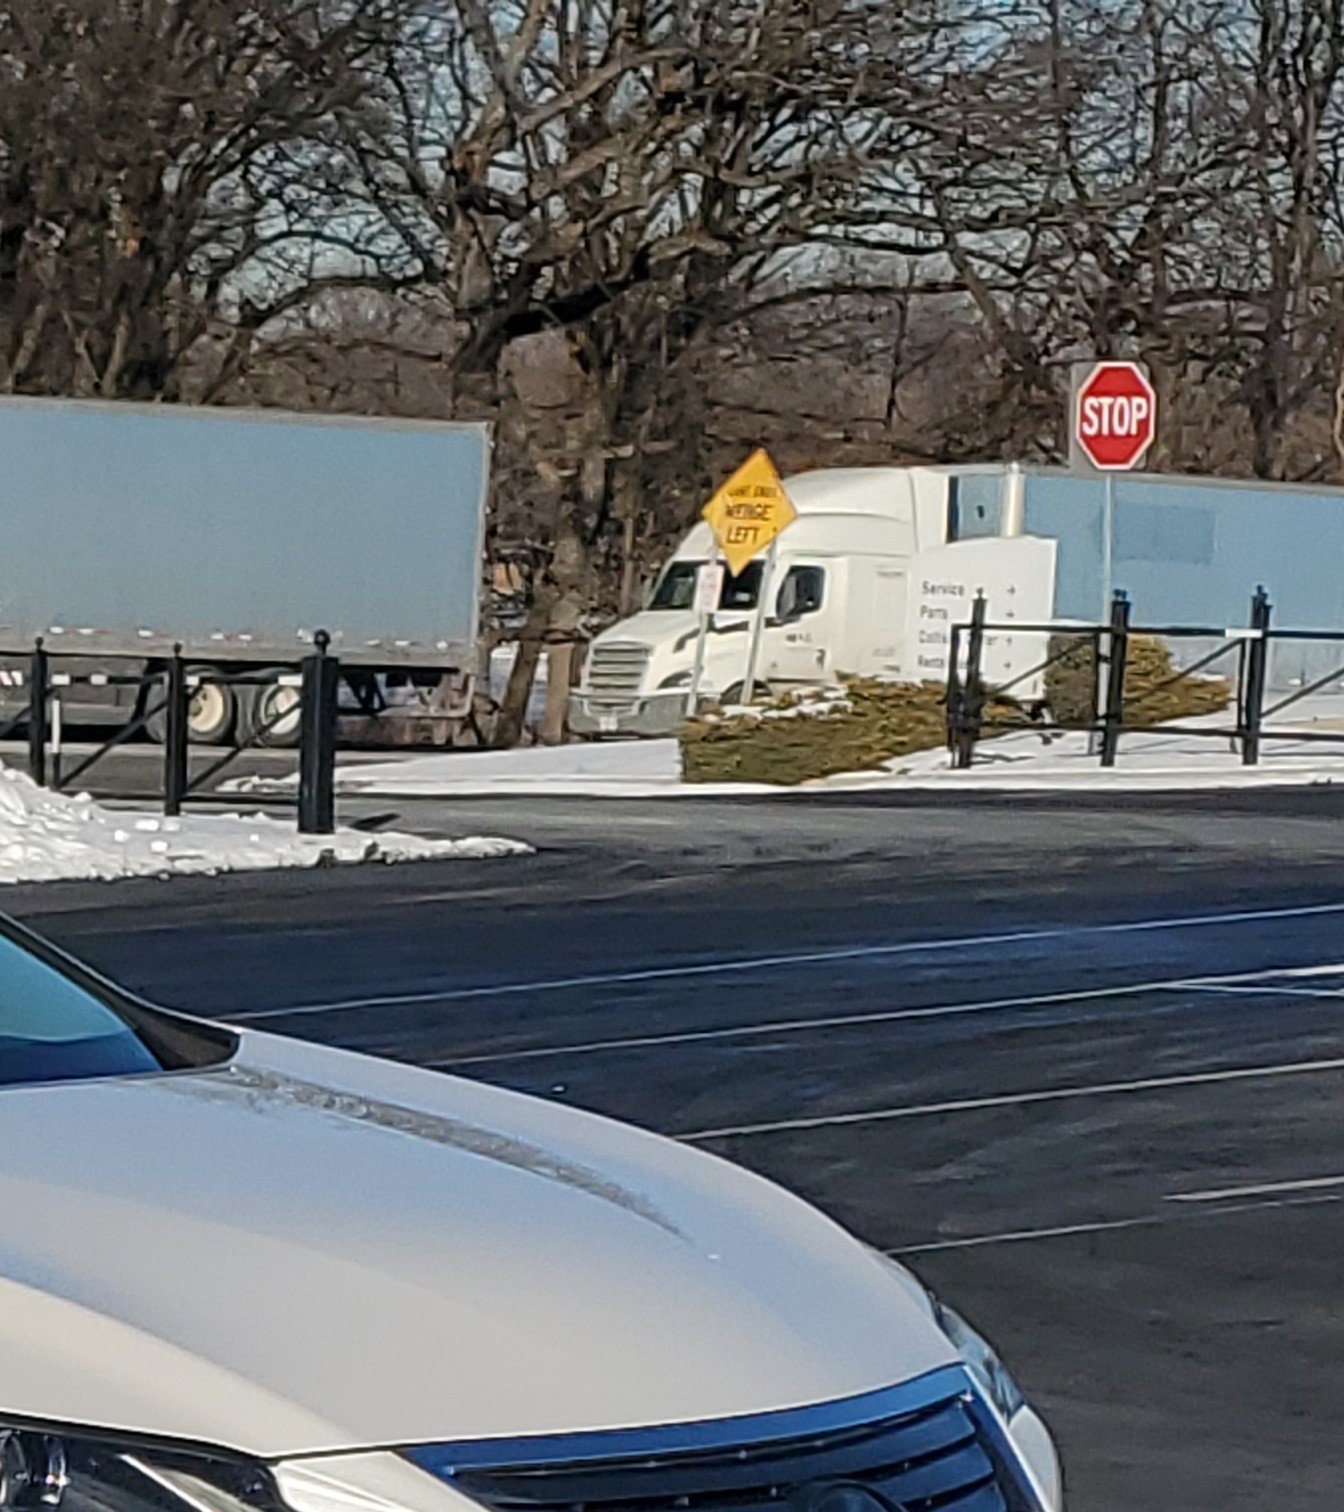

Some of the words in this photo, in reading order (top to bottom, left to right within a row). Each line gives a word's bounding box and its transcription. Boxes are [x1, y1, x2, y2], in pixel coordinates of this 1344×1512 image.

[1082, 396, 1148, 436] STOP
[725, 503, 774, 521] MERGE
[726, 526, 760, 544] LEFT
[922, 581, 965, 596] Service
